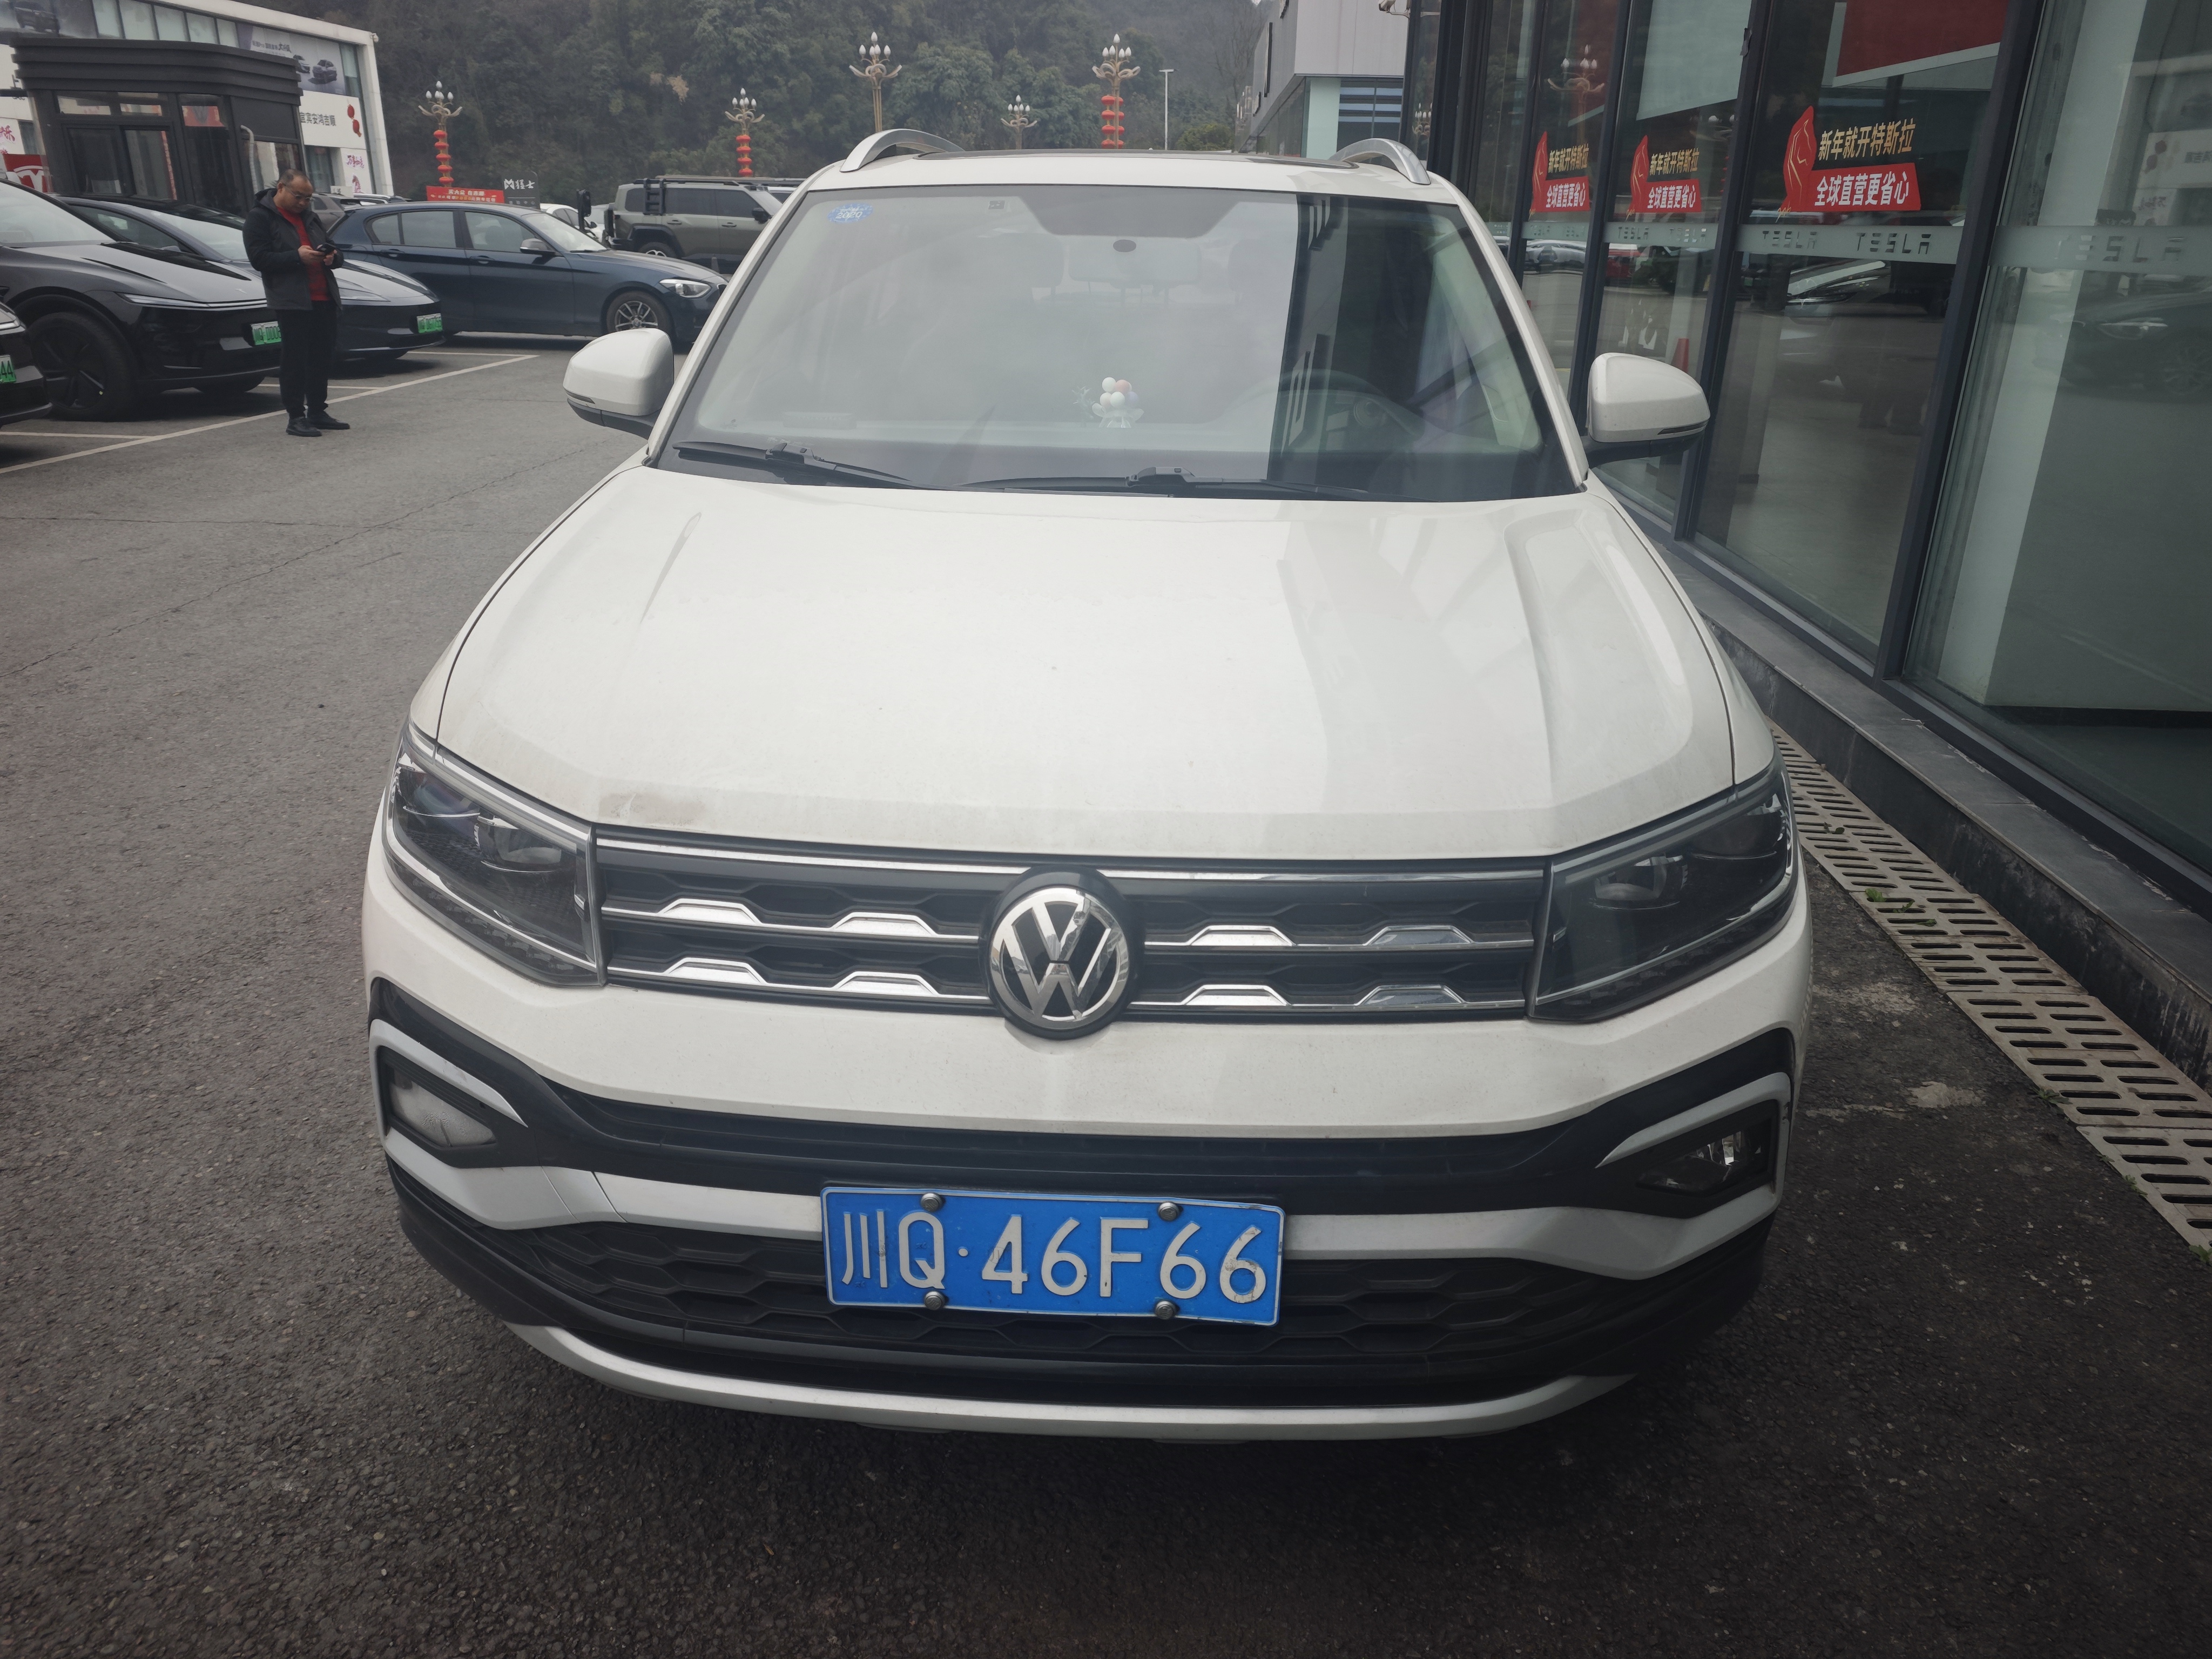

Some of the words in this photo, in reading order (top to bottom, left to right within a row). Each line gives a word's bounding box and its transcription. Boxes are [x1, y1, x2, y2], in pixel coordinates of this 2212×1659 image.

[1818, 118, 1916, 161] 新年就开特斯拉
[1548, 143, 1589, 173] 新年就开特斯拉
[1650, 147, 1700, 176] 新年就开特斯拉
[1546, 182, 1586, 208] 全球直营更省心
[1648, 184, 1696, 208] 全球直营更省心
[1815, 171, 1909, 206] 全球直营更省心
[835, 211, 862, 219] 2020
[1618, 227, 1649, 240] TESLA
[1762, 231, 1817, 249] TESLA
[1857, 233, 1931, 254] TESLA
[0, 360, 13, 378] 44
